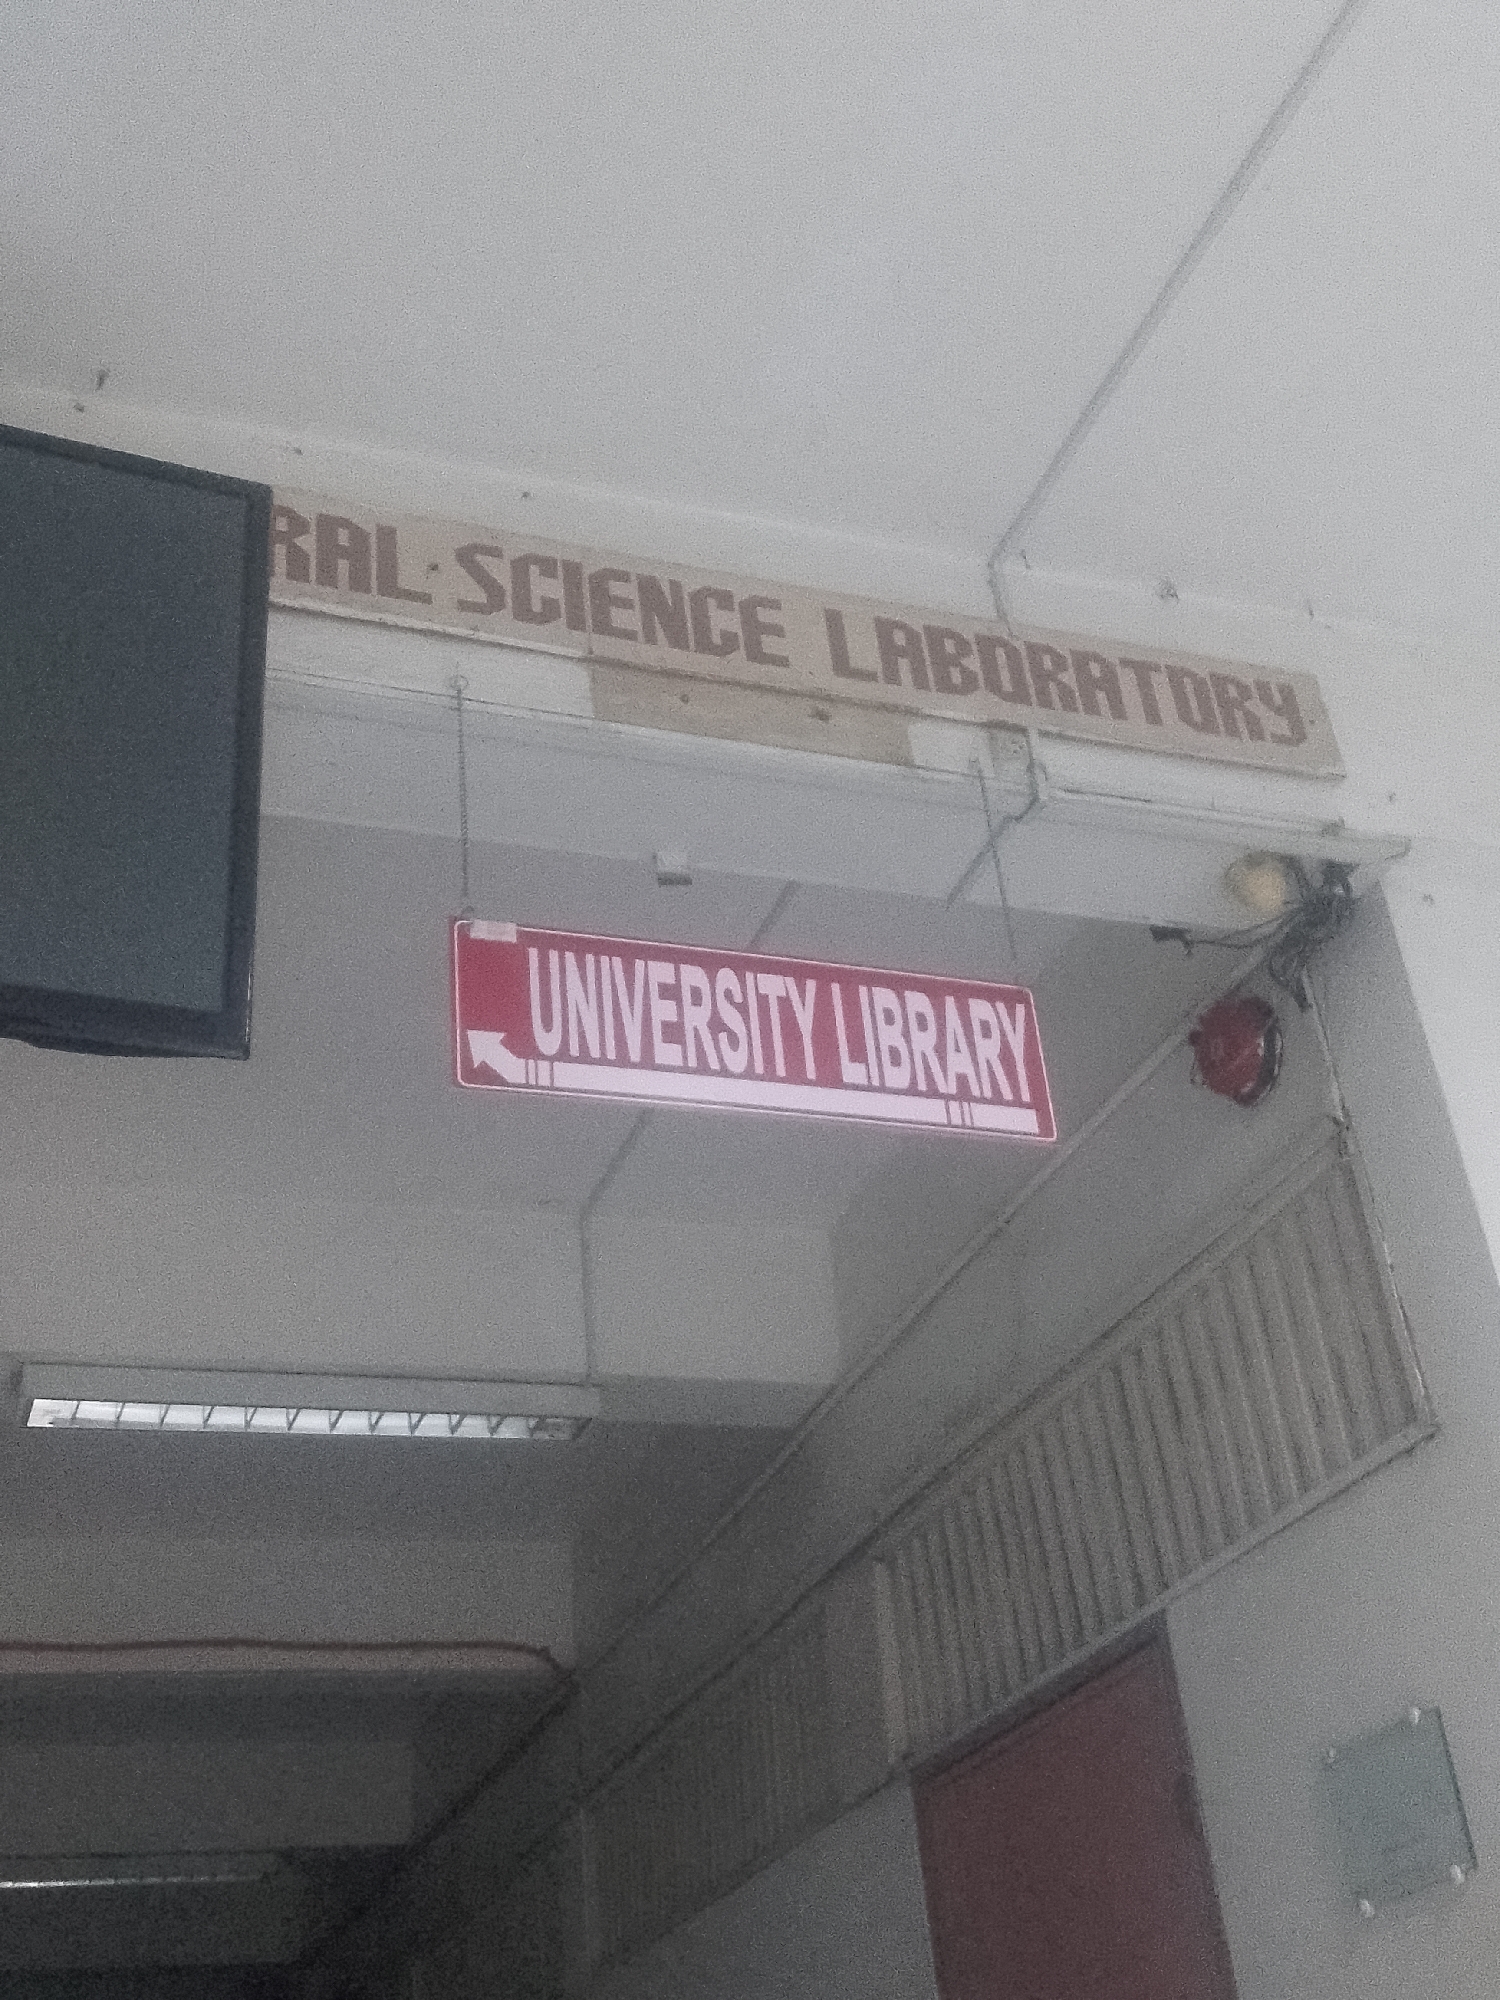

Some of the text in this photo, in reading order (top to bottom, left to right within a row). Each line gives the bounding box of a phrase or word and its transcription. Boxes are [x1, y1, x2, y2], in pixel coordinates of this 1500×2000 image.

[455, 543, 790, 667] SCIENCE
[824, 607, 1307, 747] LABORATORY
[527, 947, 1031, 1102] UNIVERSITY LIBRARY
